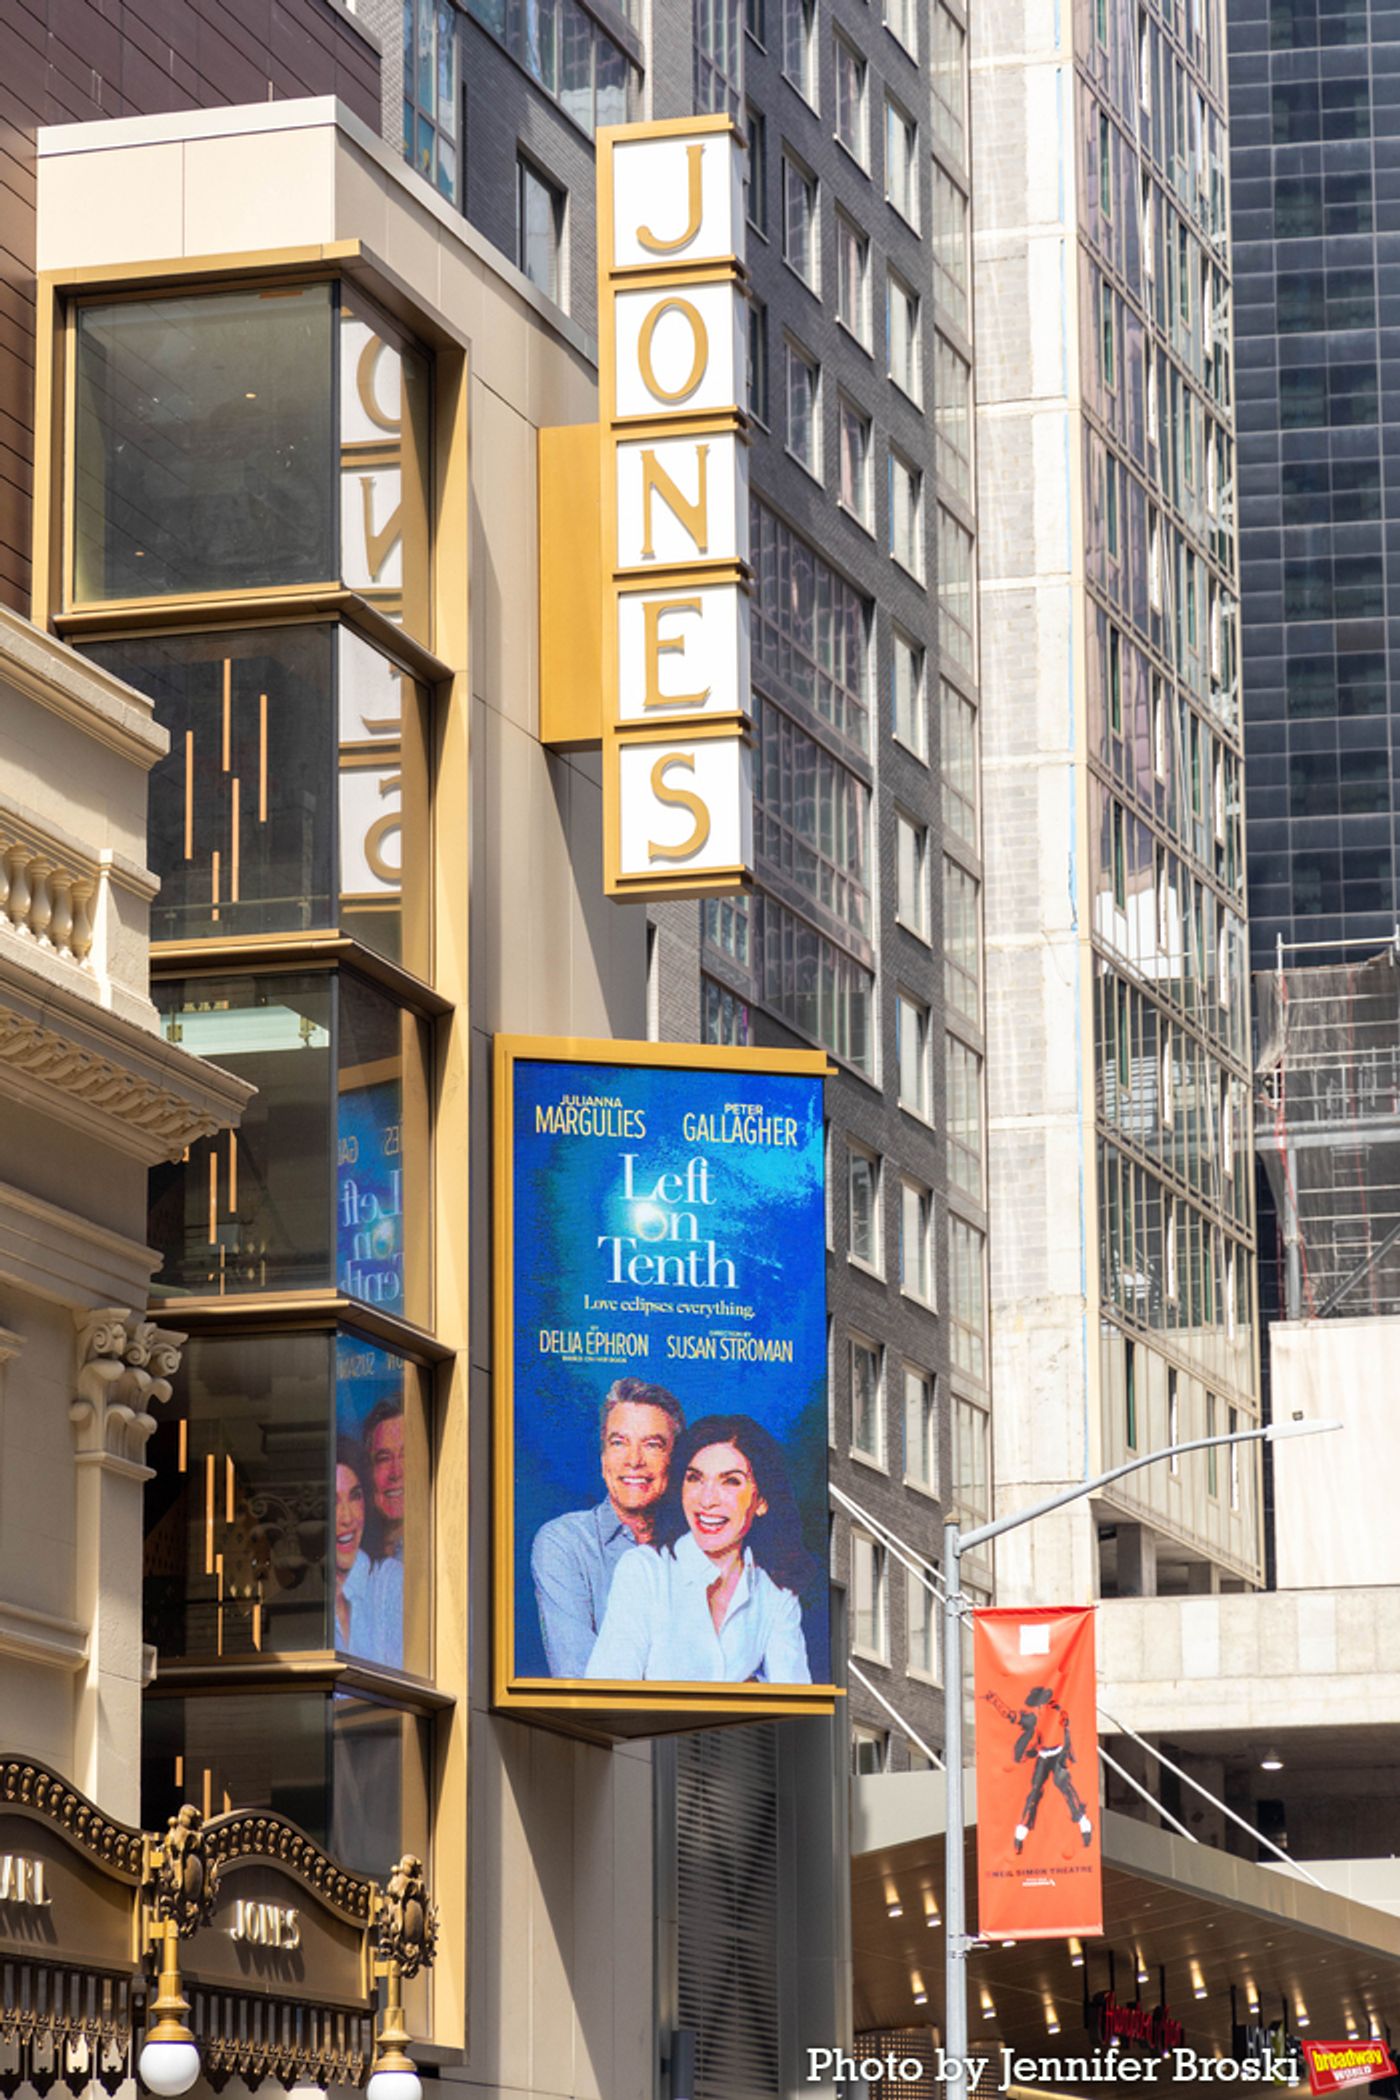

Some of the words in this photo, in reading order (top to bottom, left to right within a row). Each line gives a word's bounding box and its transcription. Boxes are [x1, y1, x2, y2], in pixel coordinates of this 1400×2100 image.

[635, 143, 712, 866] JONES
[560, 1094, 623, 1107] JULIANNA
[724, 1103, 763, 1115] PETER
[536, 1105, 646, 1139] MARGULIES
[683, 1112, 797, 1146] GALLAGHER
[618, 1153, 717, 1205] Left
[597, 1236, 740, 1289] Tenth
[584, 1294, 618, 1310] Love
[620, 1296, 674, 1317] eclipses
[540, 1330, 583, 1354] DELIA
[586, 1331, 649, 1357] EPHRON
[666, 1335, 716, 1359] SUSAN
[720, 1337, 793, 1362] STROMAN
[0, 1855, 53, 1905] ARL
[1016, 1868, 1047, 1876] SIMON
[1050, 1865, 1092, 1874] THEATRE
[228, 1899, 300, 1949] JONES
